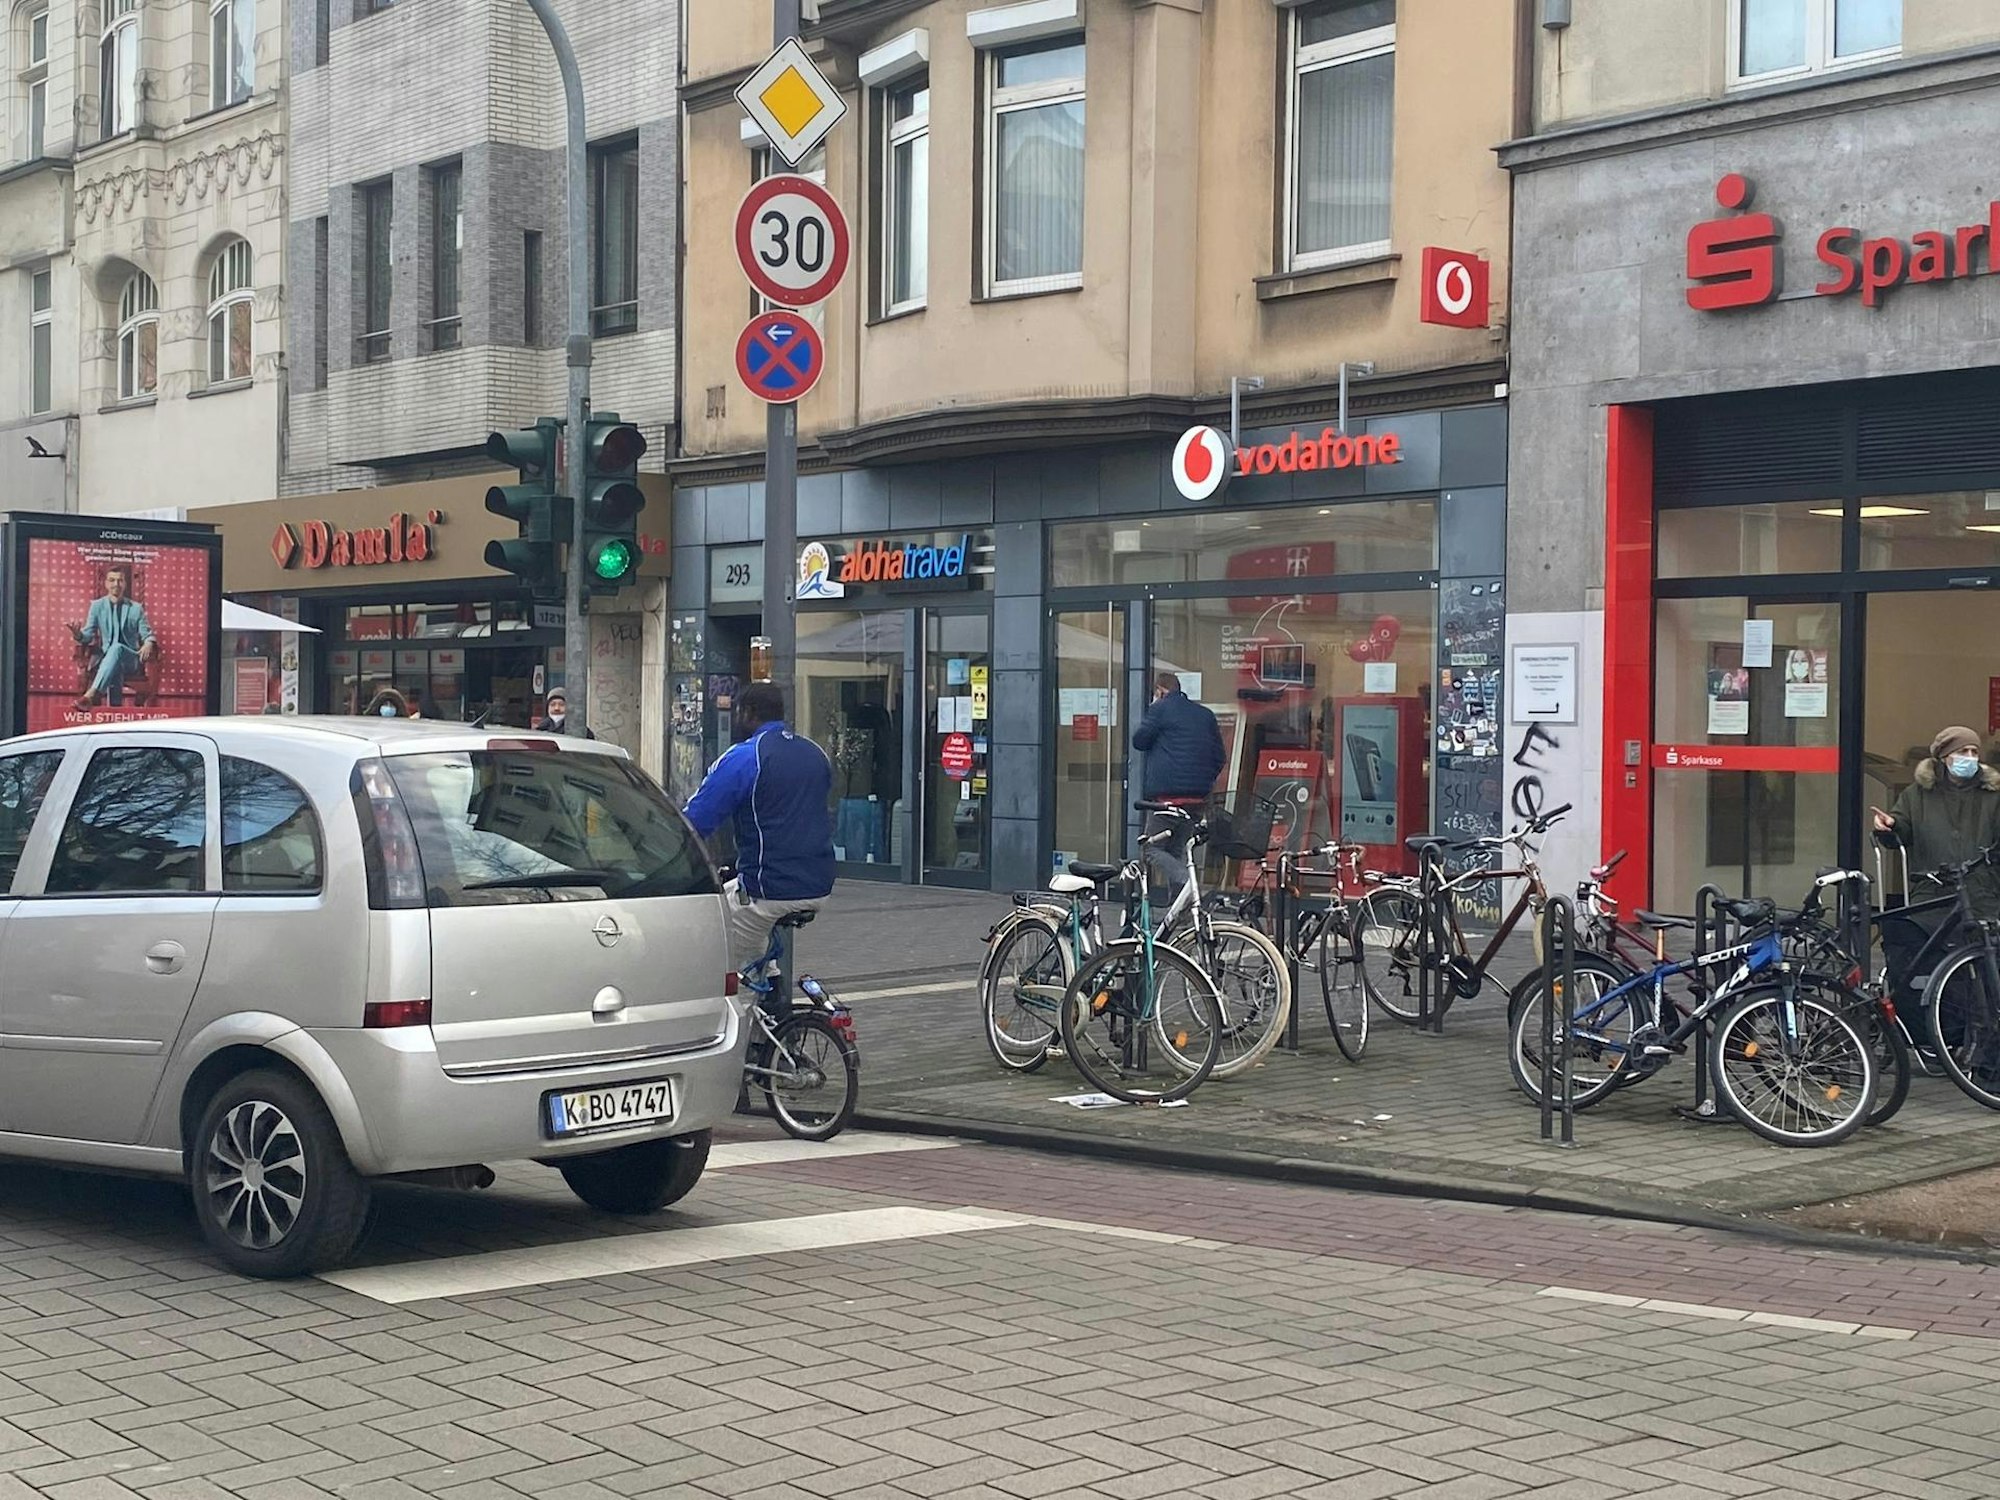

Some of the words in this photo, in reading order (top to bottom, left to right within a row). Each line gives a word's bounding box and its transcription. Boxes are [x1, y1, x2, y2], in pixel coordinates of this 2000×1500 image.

[760, 210, 825, 273] 30
[1236, 427, 1400, 476] vodafone
[100, 531, 143, 541] JCDecaux
[303, 512, 430, 568] Damla
[840, 531, 970, 583] alohatravel
[726, 563, 751, 587] 293
[63, 711, 93, 722] WER
[1277, 760, 1308, 770] vodafone
[1681, 754, 1723, 766] Sparkasse
[1697, 942, 1752, 967] SCOTT
[564, 1097, 579, 1126] K
[620, 1086, 667, 1117] 4747
